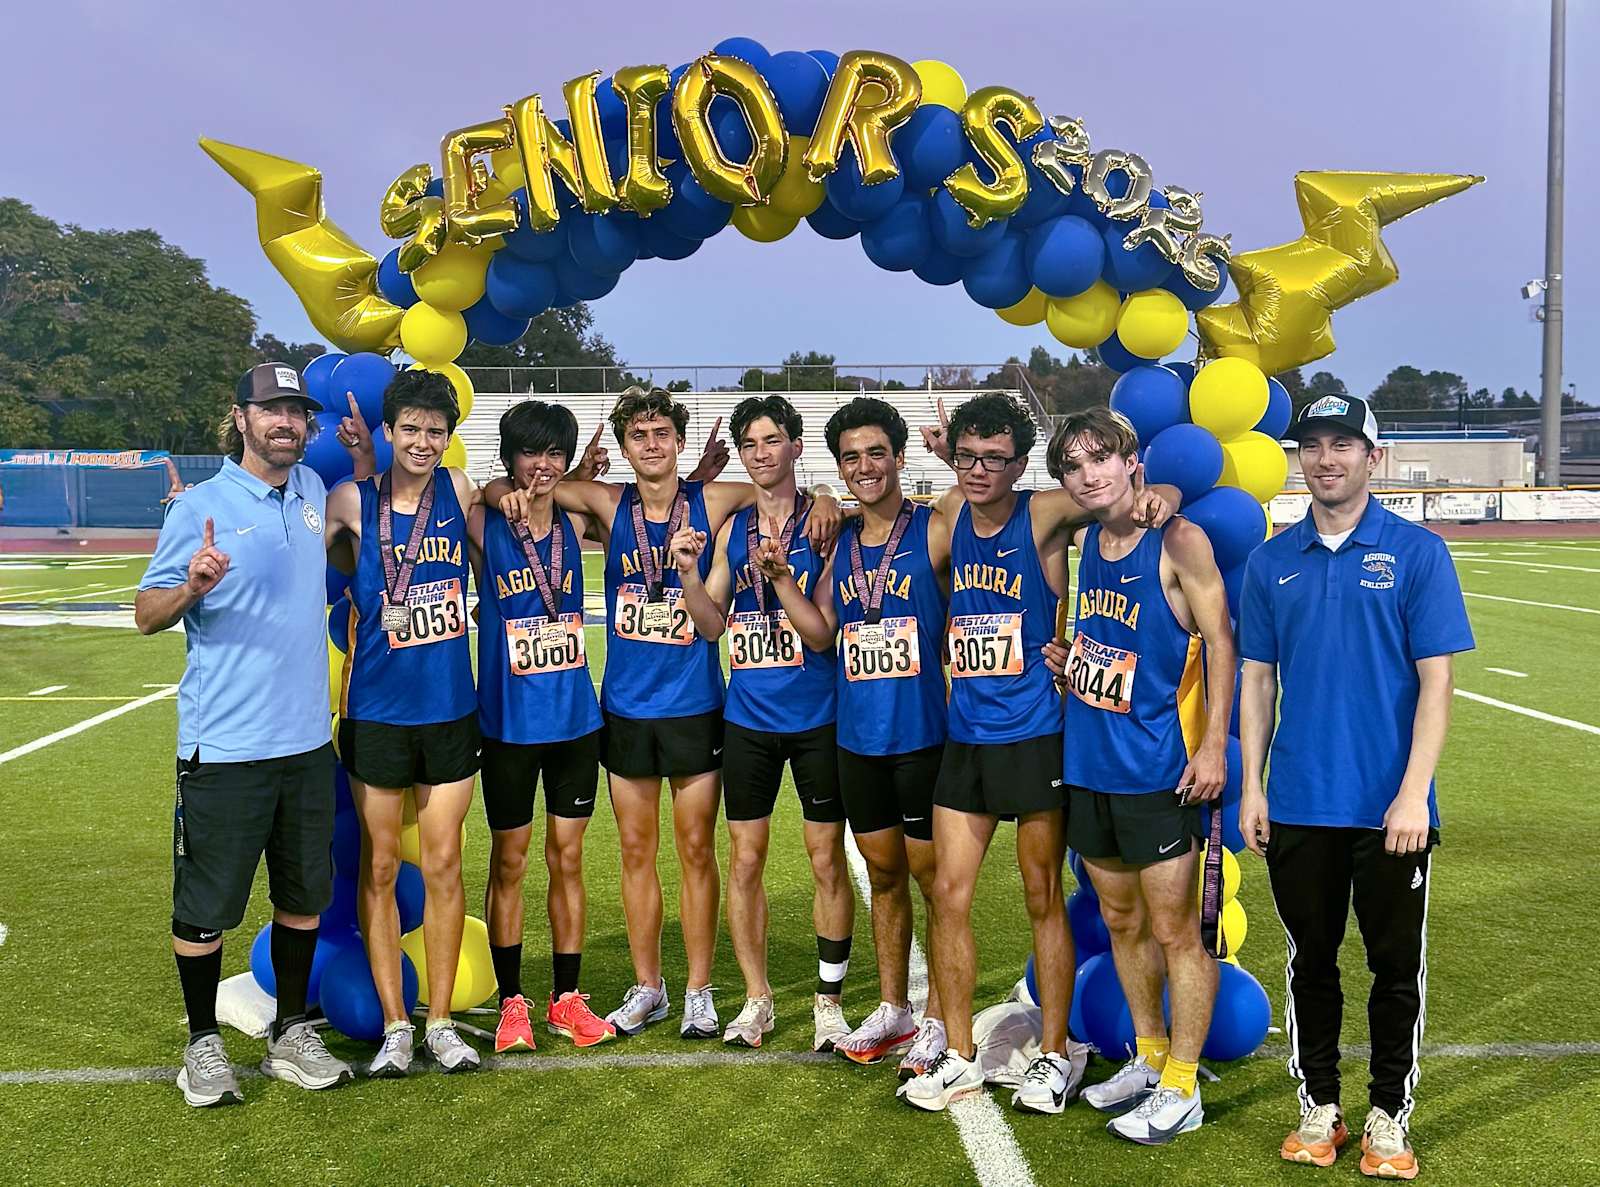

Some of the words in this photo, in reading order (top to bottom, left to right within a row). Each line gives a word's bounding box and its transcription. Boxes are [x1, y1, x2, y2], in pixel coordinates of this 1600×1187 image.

[381, 50, 1045, 273] SENIORS
[1362, 552, 1396, 565] AGOURA
[953, 563, 1023, 600] AGOURA
[954, 614, 1013, 627] WESTLAKE
[1078, 588, 1141, 631] AGOURA
[733, 629, 795, 665] 3048
[963, 625, 999, 637] TIMING
[954, 635, 1013, 672] 3057
[1071, 655, 1124, 707] 3044
